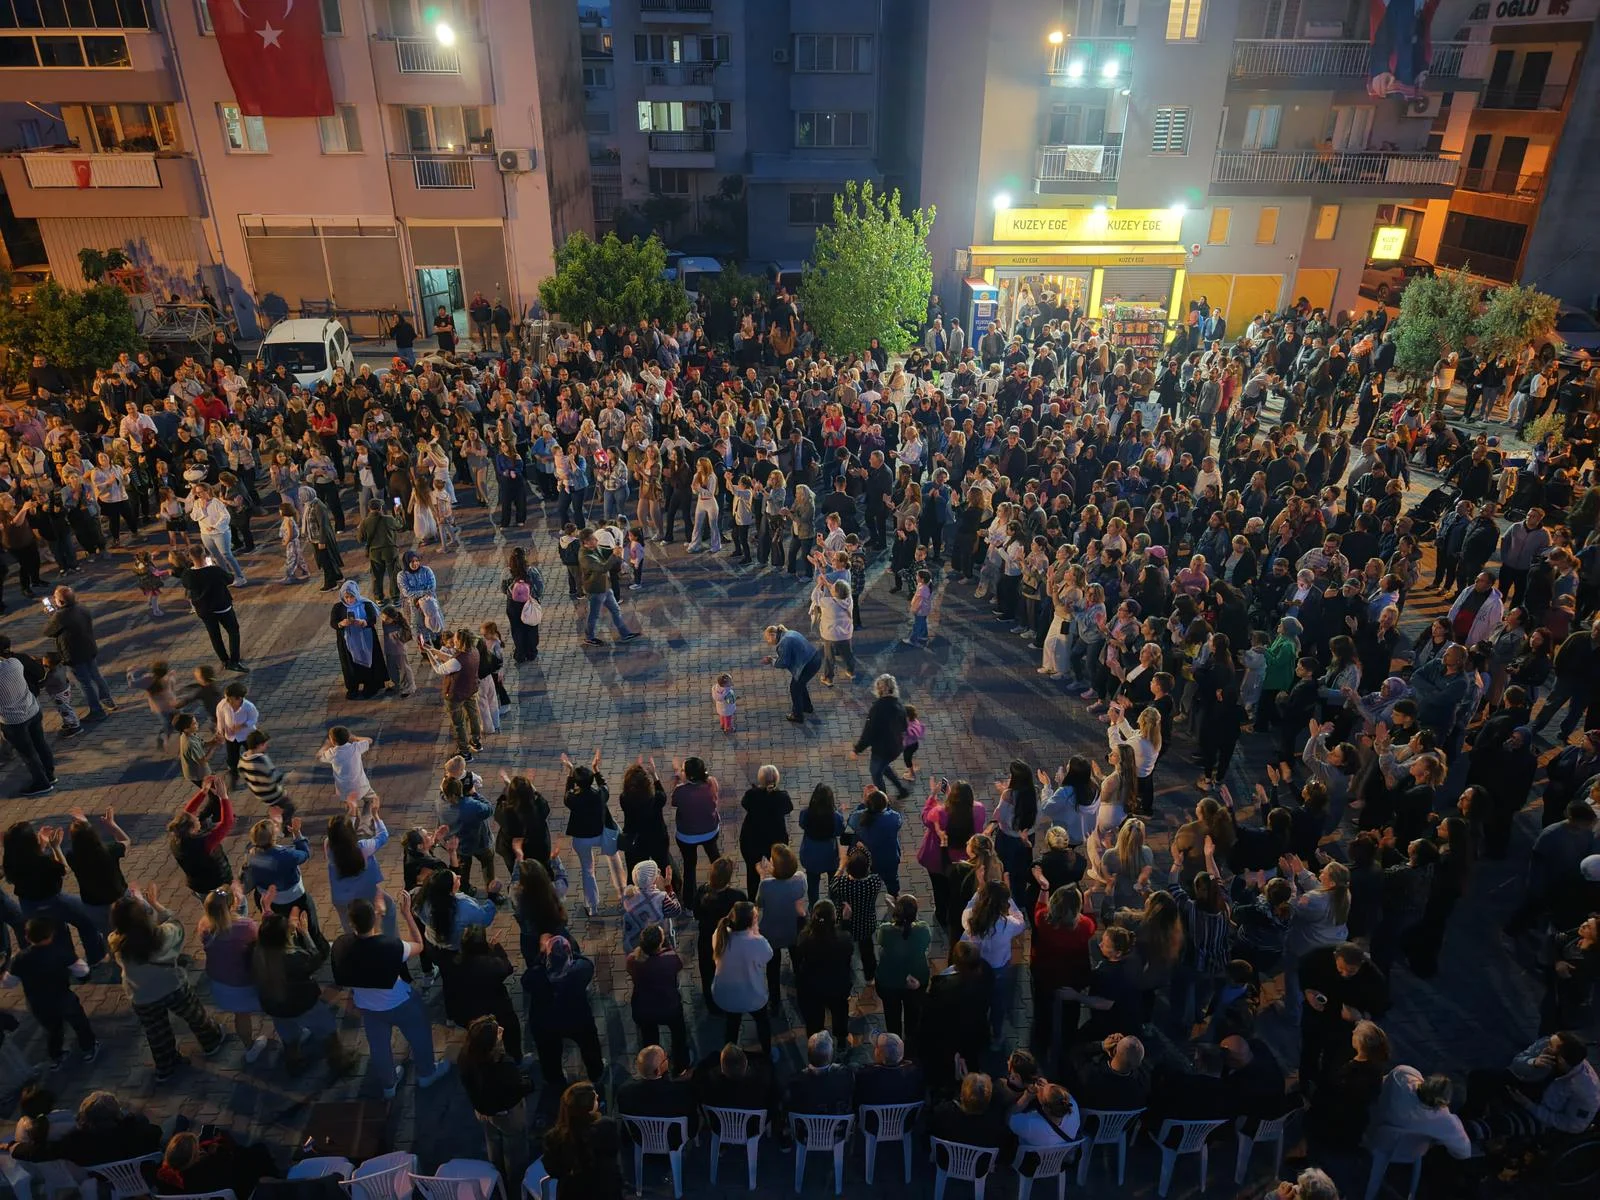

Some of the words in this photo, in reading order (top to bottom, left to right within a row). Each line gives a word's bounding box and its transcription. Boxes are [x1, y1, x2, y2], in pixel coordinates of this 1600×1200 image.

[1013, 219, 1046, 230] KUZEY
[1048, 219, 1068, 230] EGE
[1107, 219, 1140, 231] KUZEY
[1142, 219, 1162, 231] EGE
